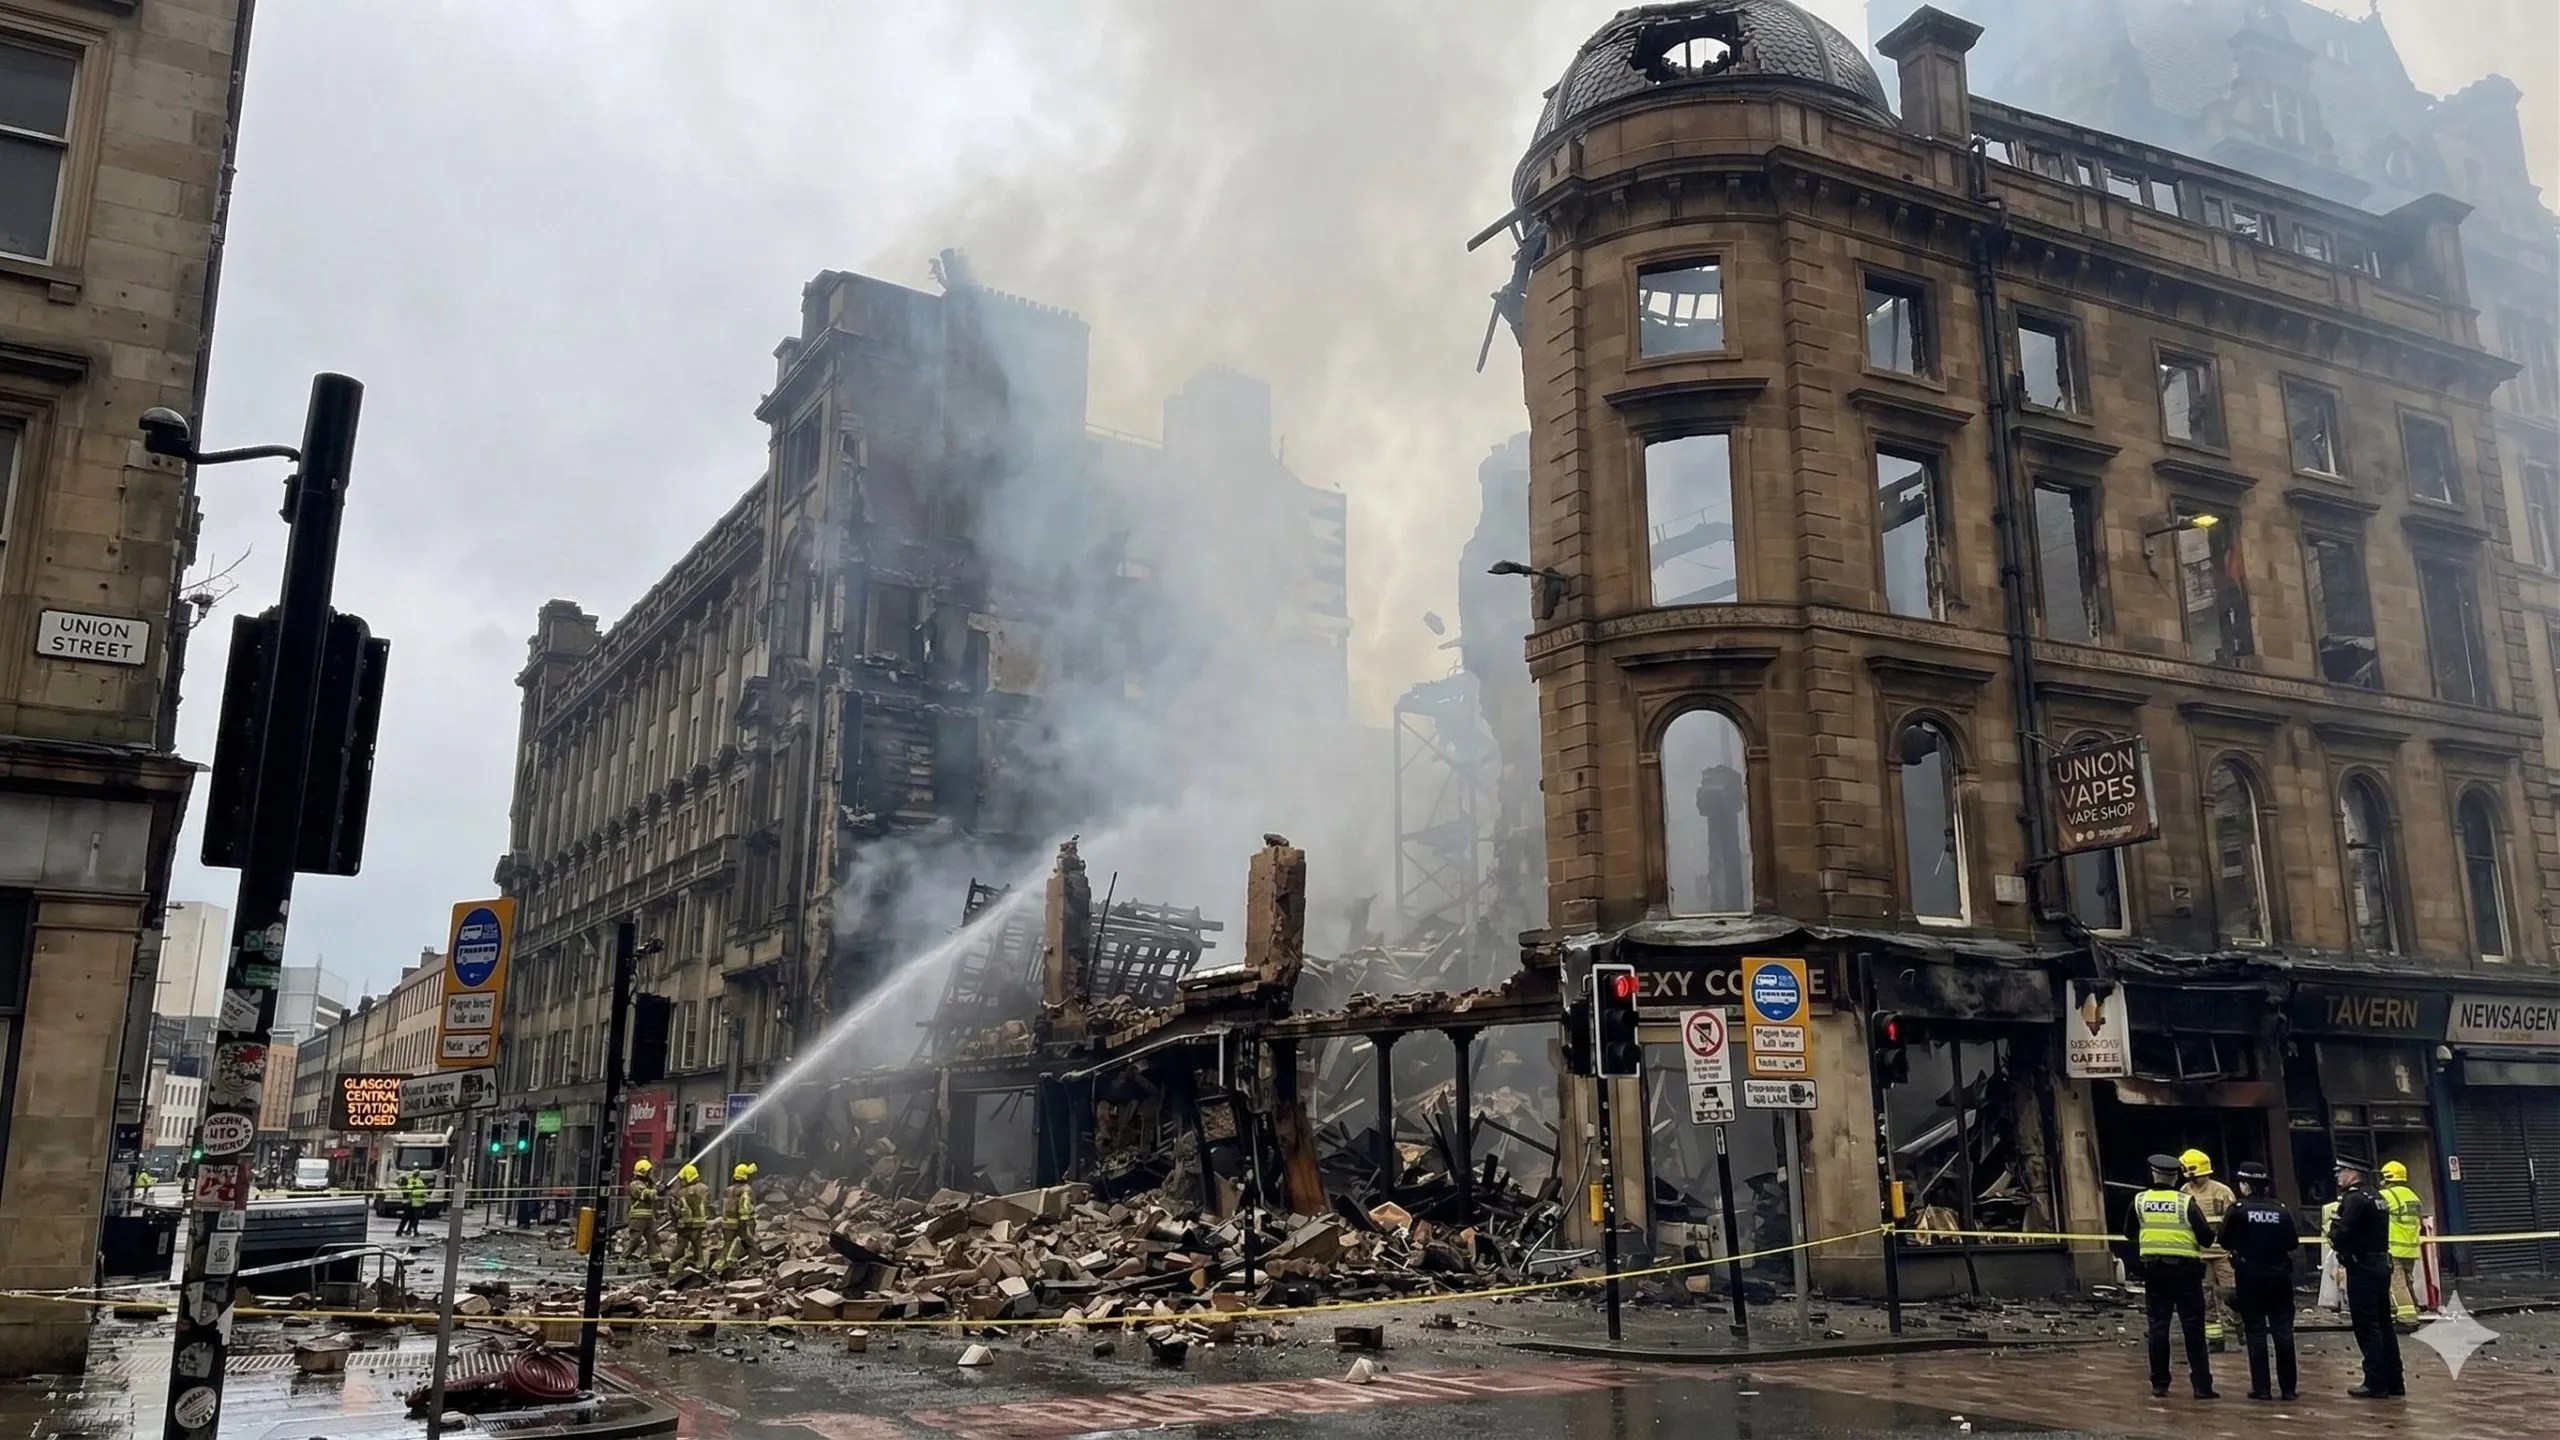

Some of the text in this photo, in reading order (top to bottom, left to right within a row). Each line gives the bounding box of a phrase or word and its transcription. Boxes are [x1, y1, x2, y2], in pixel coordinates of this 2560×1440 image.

[60, 618, 129, 638] UNION
[51, 637, 132, 658] STREET
[2057, 747, 2135, 783] UNION
[2060, 775, 2136, 809] VAPES
[2067, 802, 2135, 825] VAPE SHOP
[2325, 995, 2418, 1030] TAVERN
[2460, 1003, 2560, 1031] NEWSAGEN
[346, 1090, 399, 1102] CENTRAL
[348, 1103, 399, 1114] STATION
